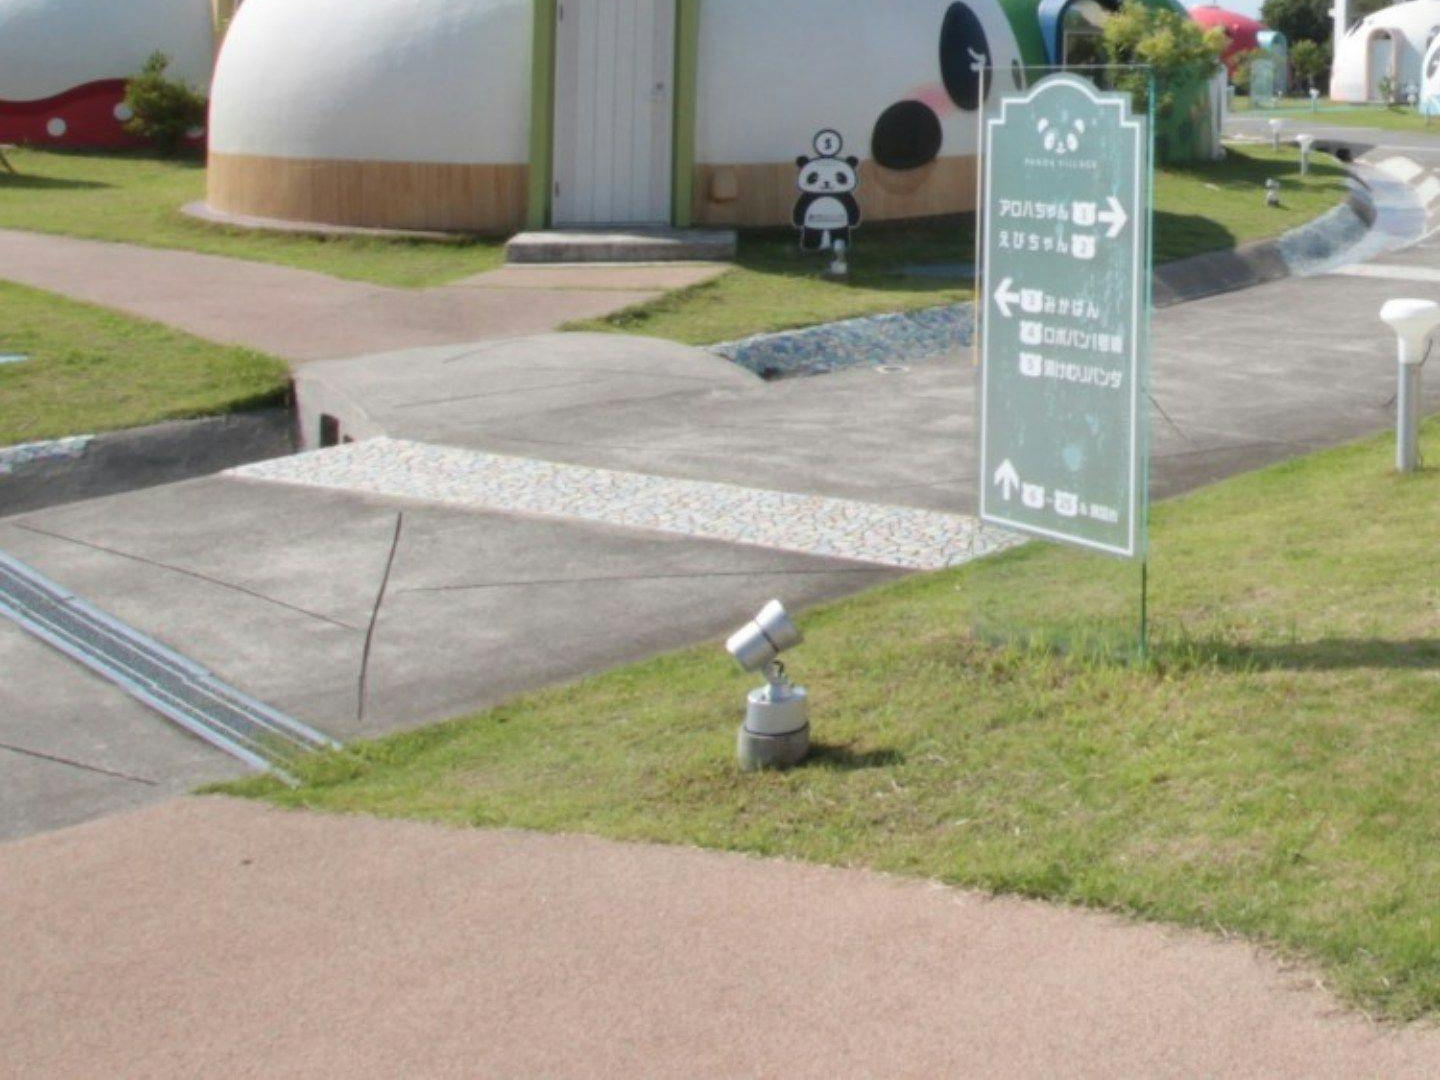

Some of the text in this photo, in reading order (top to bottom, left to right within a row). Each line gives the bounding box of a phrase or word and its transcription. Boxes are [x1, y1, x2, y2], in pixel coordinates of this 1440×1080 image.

[1024, 157, 1098, 170] PANDA VILLAGE
[998, 199, 1069, 221] アロハちゃん
[998, 231, 1068, 253] えびちゃん
